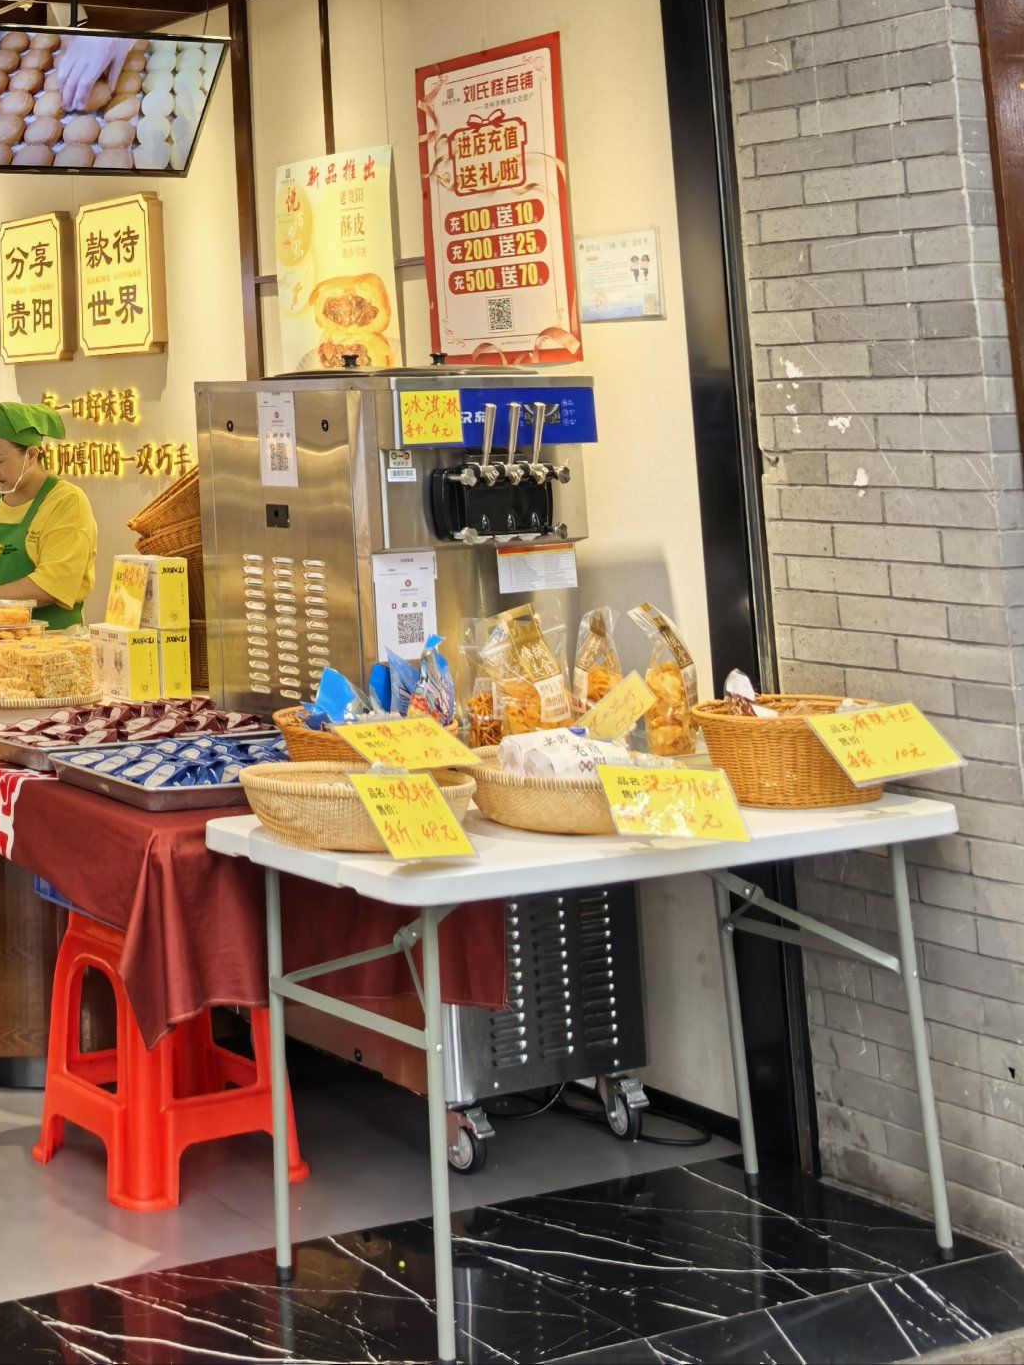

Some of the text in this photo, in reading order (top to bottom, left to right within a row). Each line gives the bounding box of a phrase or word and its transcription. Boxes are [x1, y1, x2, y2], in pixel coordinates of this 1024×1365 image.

[463, 71, 534, 103] 刘氏糕点铺
[458, 126, 519, 159] 进店充值
[306, 154, 376, 190] 新品推出
[460, 157, 520, 189] 送礼啦
[5, 241, 54, 282] 分享
[85, 225, 140, 269] 款待
[6, 298, 53, 337] 贵阳
[87, 284, 144, 326] 世界
[404, 395, 460, 421] 冰淇淋
